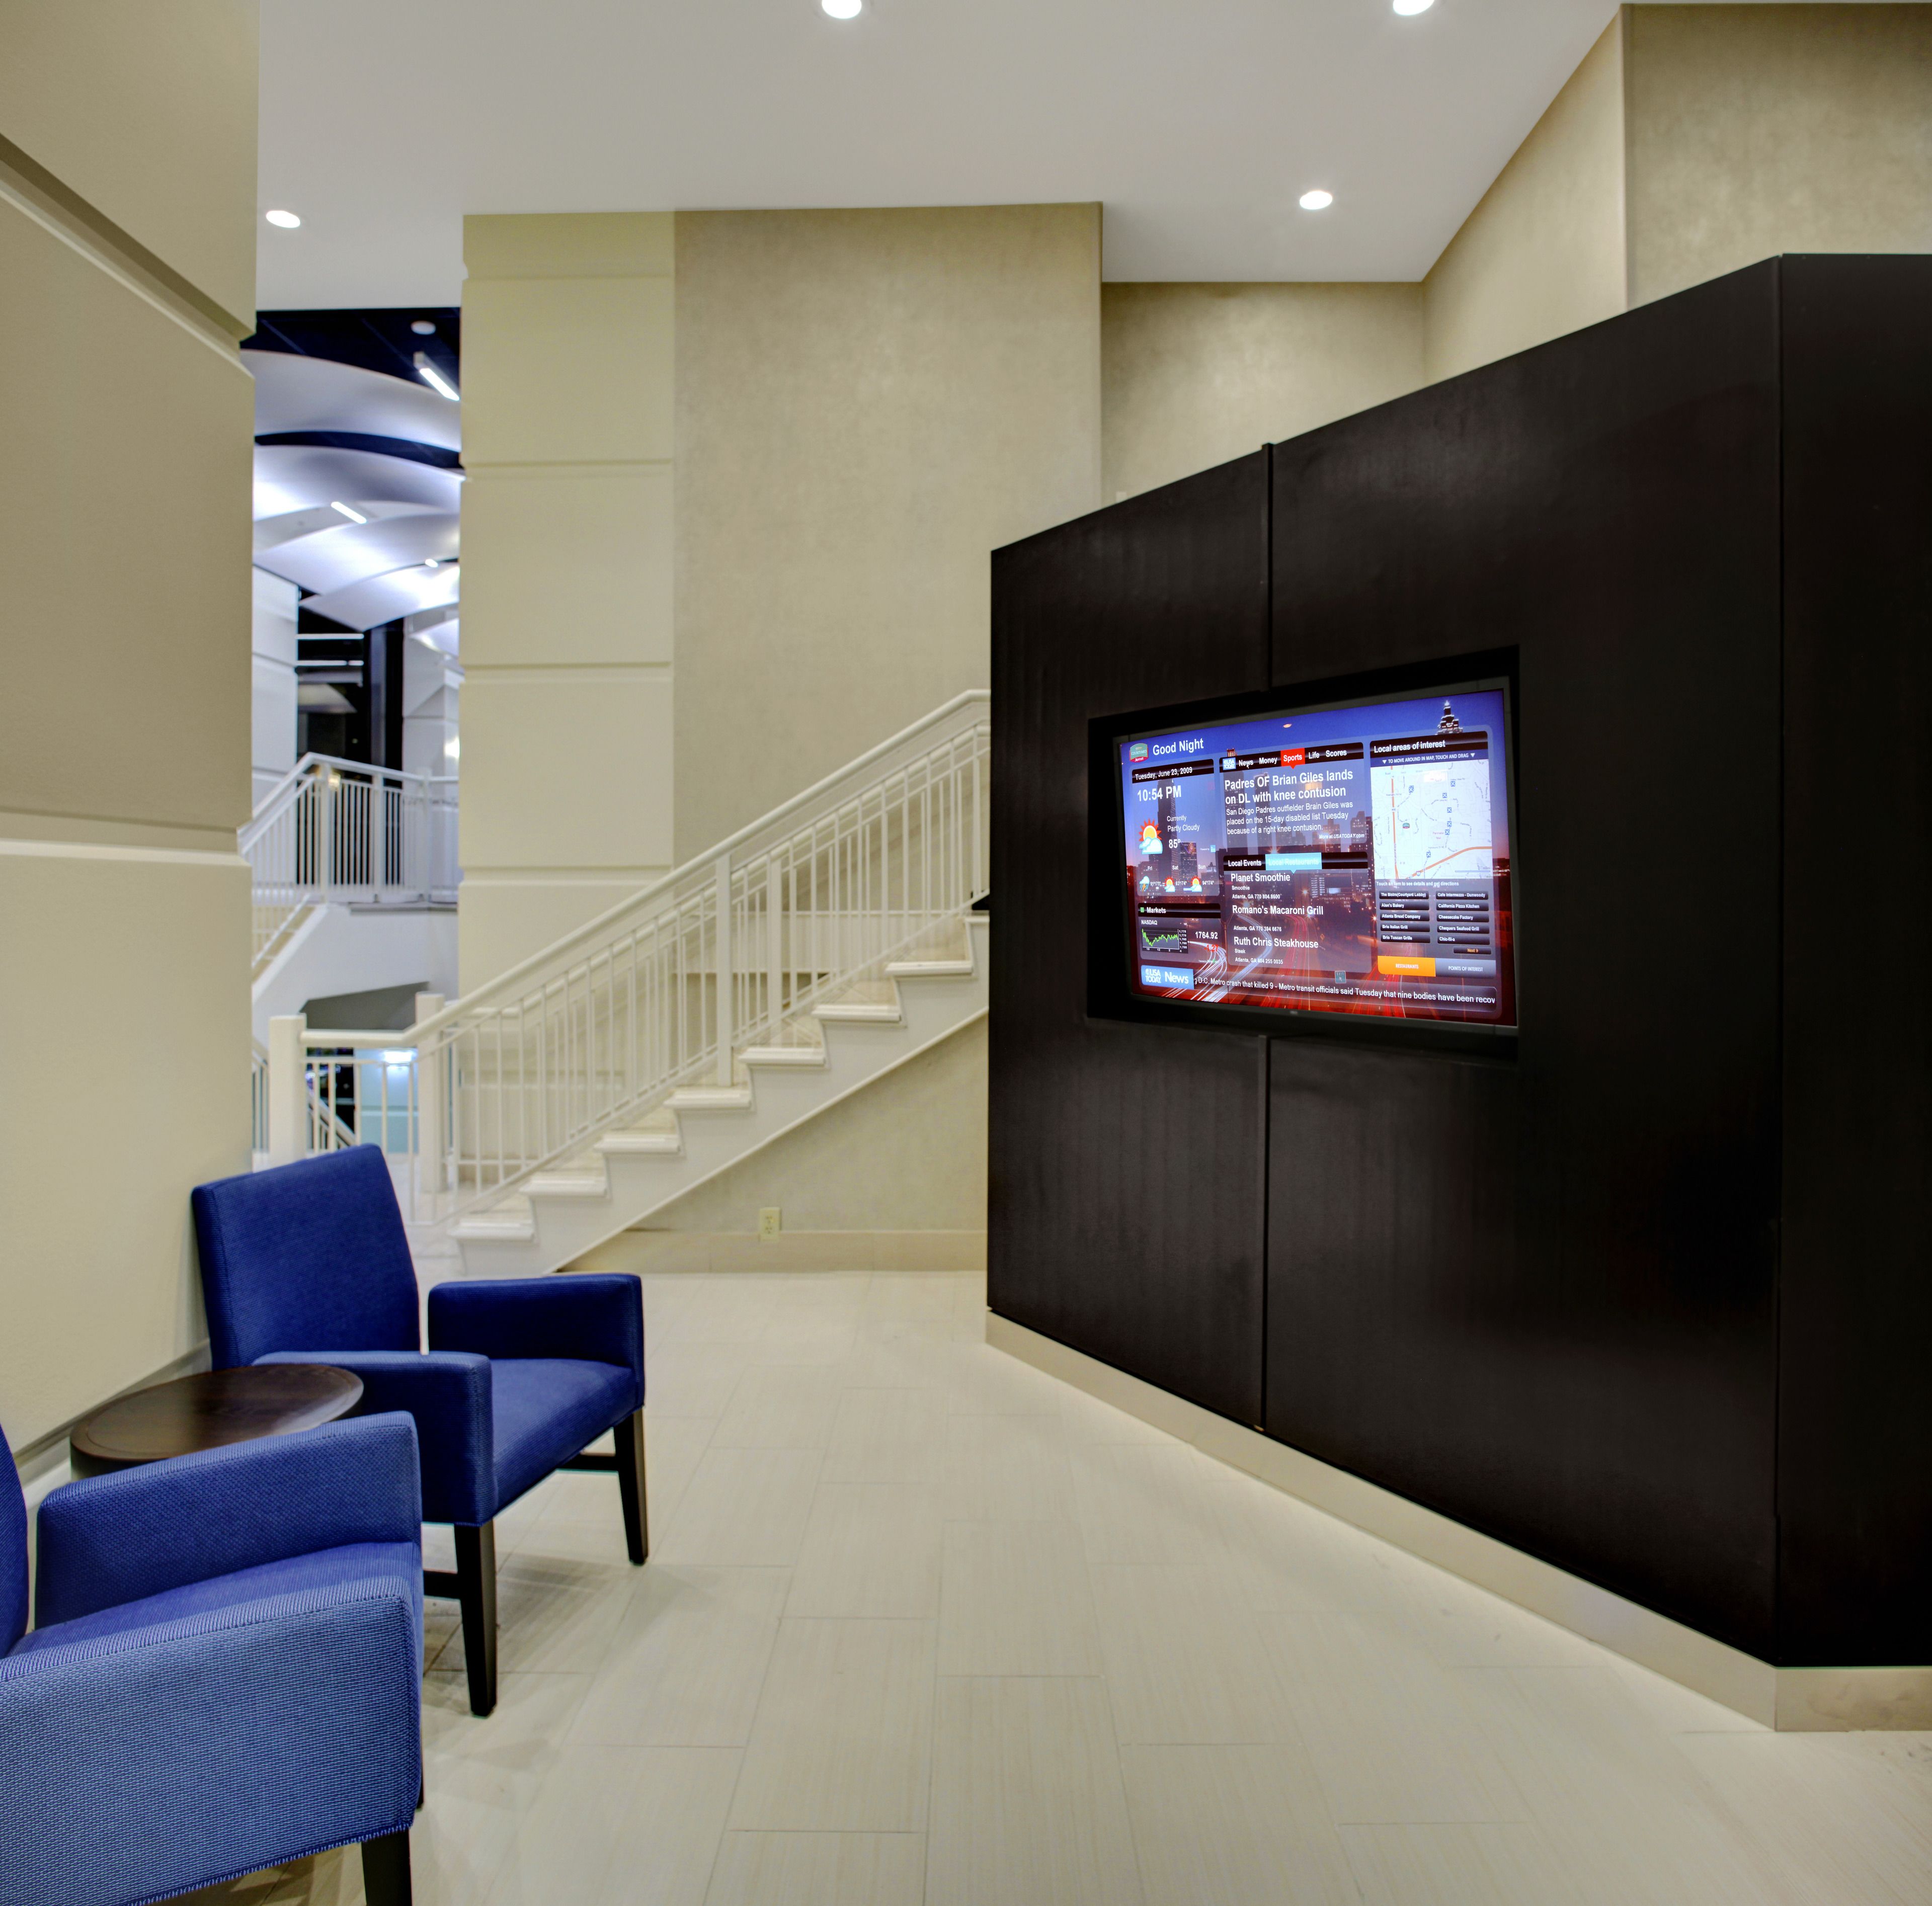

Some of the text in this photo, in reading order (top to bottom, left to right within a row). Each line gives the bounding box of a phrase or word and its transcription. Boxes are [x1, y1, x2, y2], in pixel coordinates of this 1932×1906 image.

[1153, 738, 1203, 755] Good Night
[1374, 744, 1391, 753] Local
[1420, 740, 1445, 749] interest
[1283, 755, 1302, 763] Sports
[1225, 769, 1353, 790] Padres OF Brian Giles lands
[1138, 785, 1181, 801] 10:54 PM
[1226, 787, 1346, 804] on DL with knee contusion
[1227, 818, 1244, 826] placed
[1265, 815, 1284, 823] 15-day
[1322, 811, 1348, 820] Tuesday
[1231, 873, 1290, 882] Planet Smoothie
[1233, 905, 1323, 915] Romano's Macaroni Grill
[1234, 937, 1318, 948] Ruth Chris Steakhouse
[1165, 972, 1189, 984] News
[1355, 988, 1382, 998] Tuesday
[1414, 992, 1436, 1000] bodies
